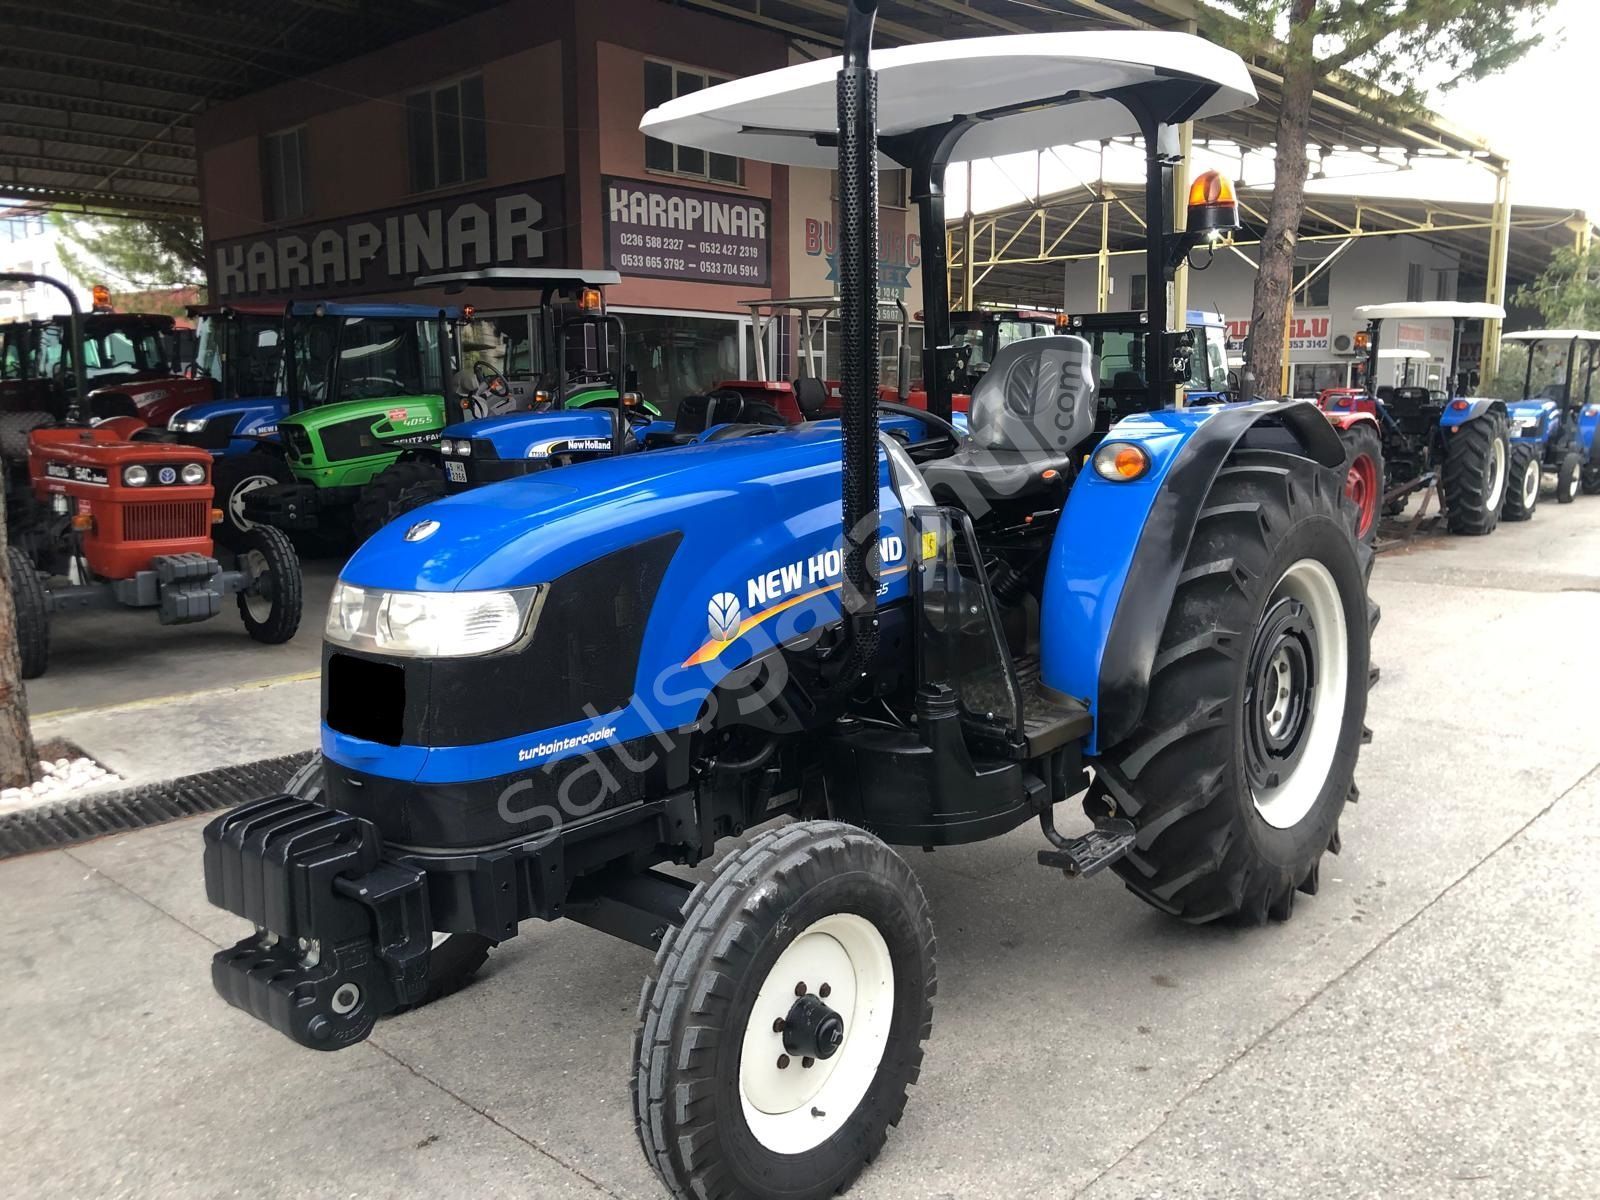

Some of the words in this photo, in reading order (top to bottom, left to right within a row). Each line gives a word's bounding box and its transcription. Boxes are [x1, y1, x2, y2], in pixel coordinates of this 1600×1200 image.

[609, 187, 765, 240] KARAPINAR
[216, 193, 544, 296] KARAPINAR
[620, 232, 643, 247] 0236
[645, 235, 662, 249] 588
[663, 237, 684, 251] 2327
[699, 241, 721, 255] 0532
[722, 244, 737, 256] 427
[739, 247, 758, 259] 2319
[621, 253, 644, 268] 0533
[645, 256, 662, 269] 665
[663, 258, 685, 271] 3792
[699, 261, 721, 274] 0533
[722, 263, 738, 276] 704
[739, 265, 759, 277] 5914
[1306, 339, 1328, 349] 3142
[567, 440, 585, 450] New
[584, 440, 611, 450] Holland
[747, 561, 804, 609] NEW
[518, 726, 617, 761] turbointercooler
